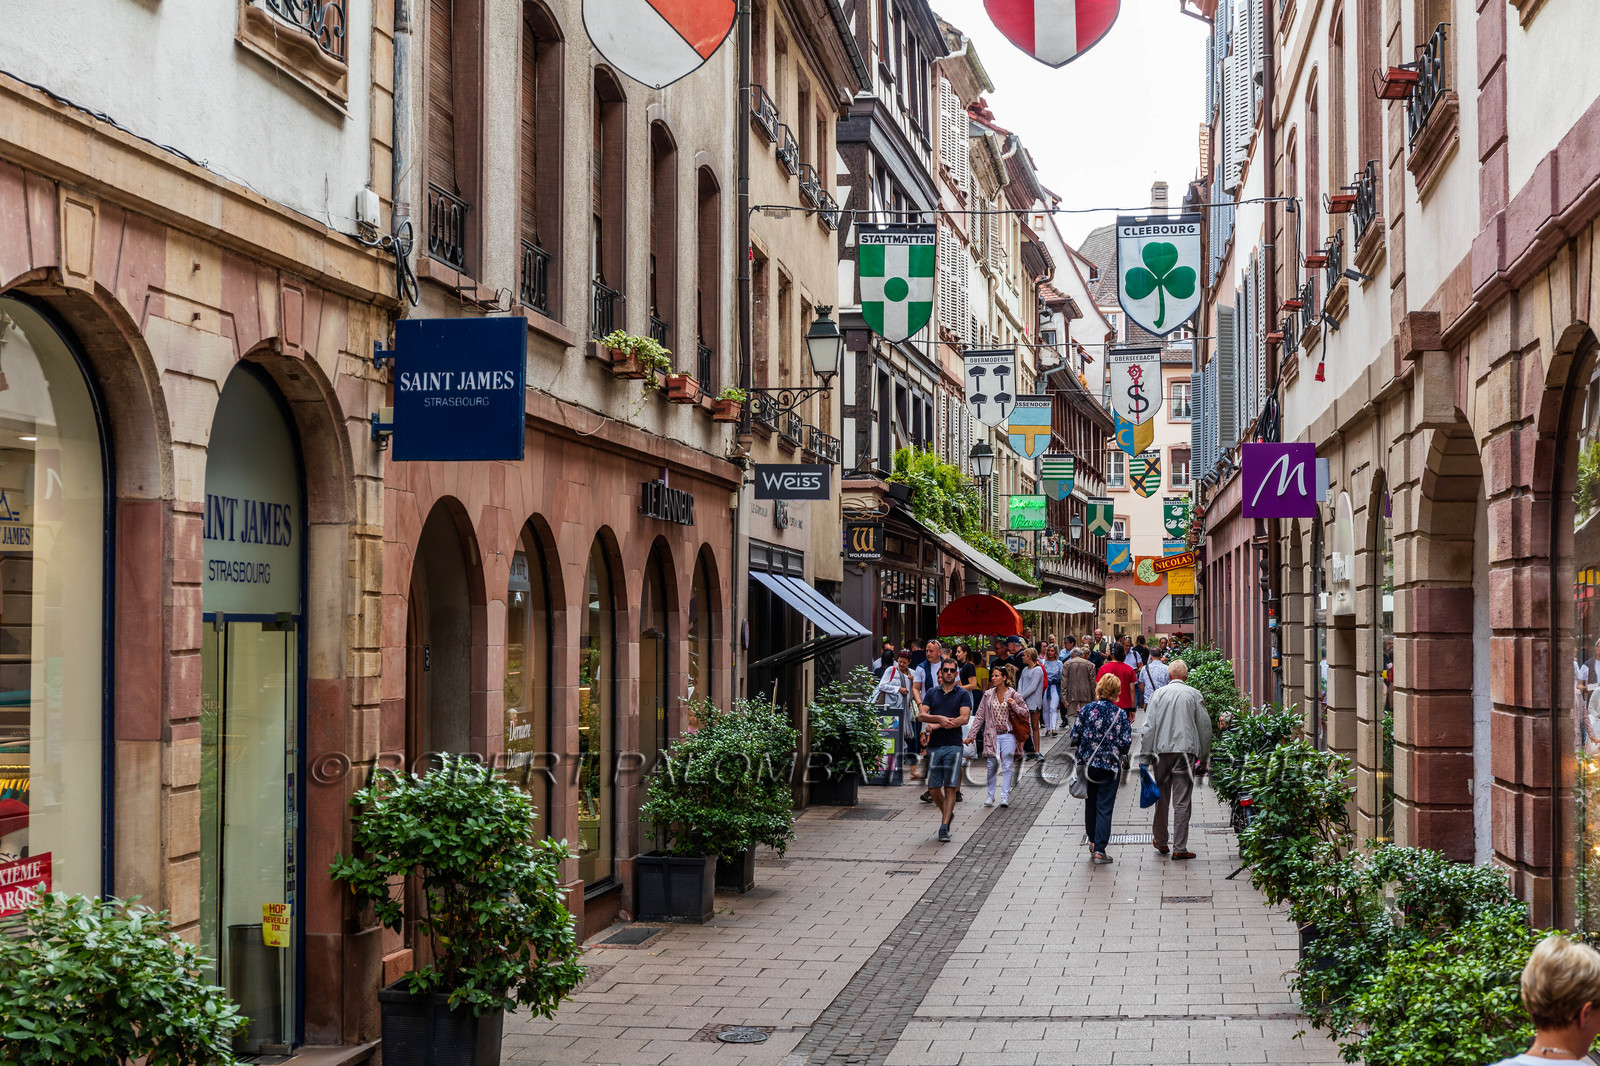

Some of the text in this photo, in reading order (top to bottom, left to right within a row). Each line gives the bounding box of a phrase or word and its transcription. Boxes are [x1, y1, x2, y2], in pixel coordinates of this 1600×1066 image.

[861, 234, 934, 244] STATTMATTEN
[1123, 225, 1196, 236] CLEEBOURG
[400, 371, 515, 391] SAINT JAMES
[424, 397, 489, 407] STRASBOURG
[762, 471, 822, 491] Weiss
[1251, 453, 1308, 508] M
[241, 499, 292, 548] JAMES
[2, 526, 31, 546] JAMES
[208, 558, 271, 584] STRASBOURG
[1154, 553, 1193, 571] NICOLAS
[269, 903, 287, 914] HOP
